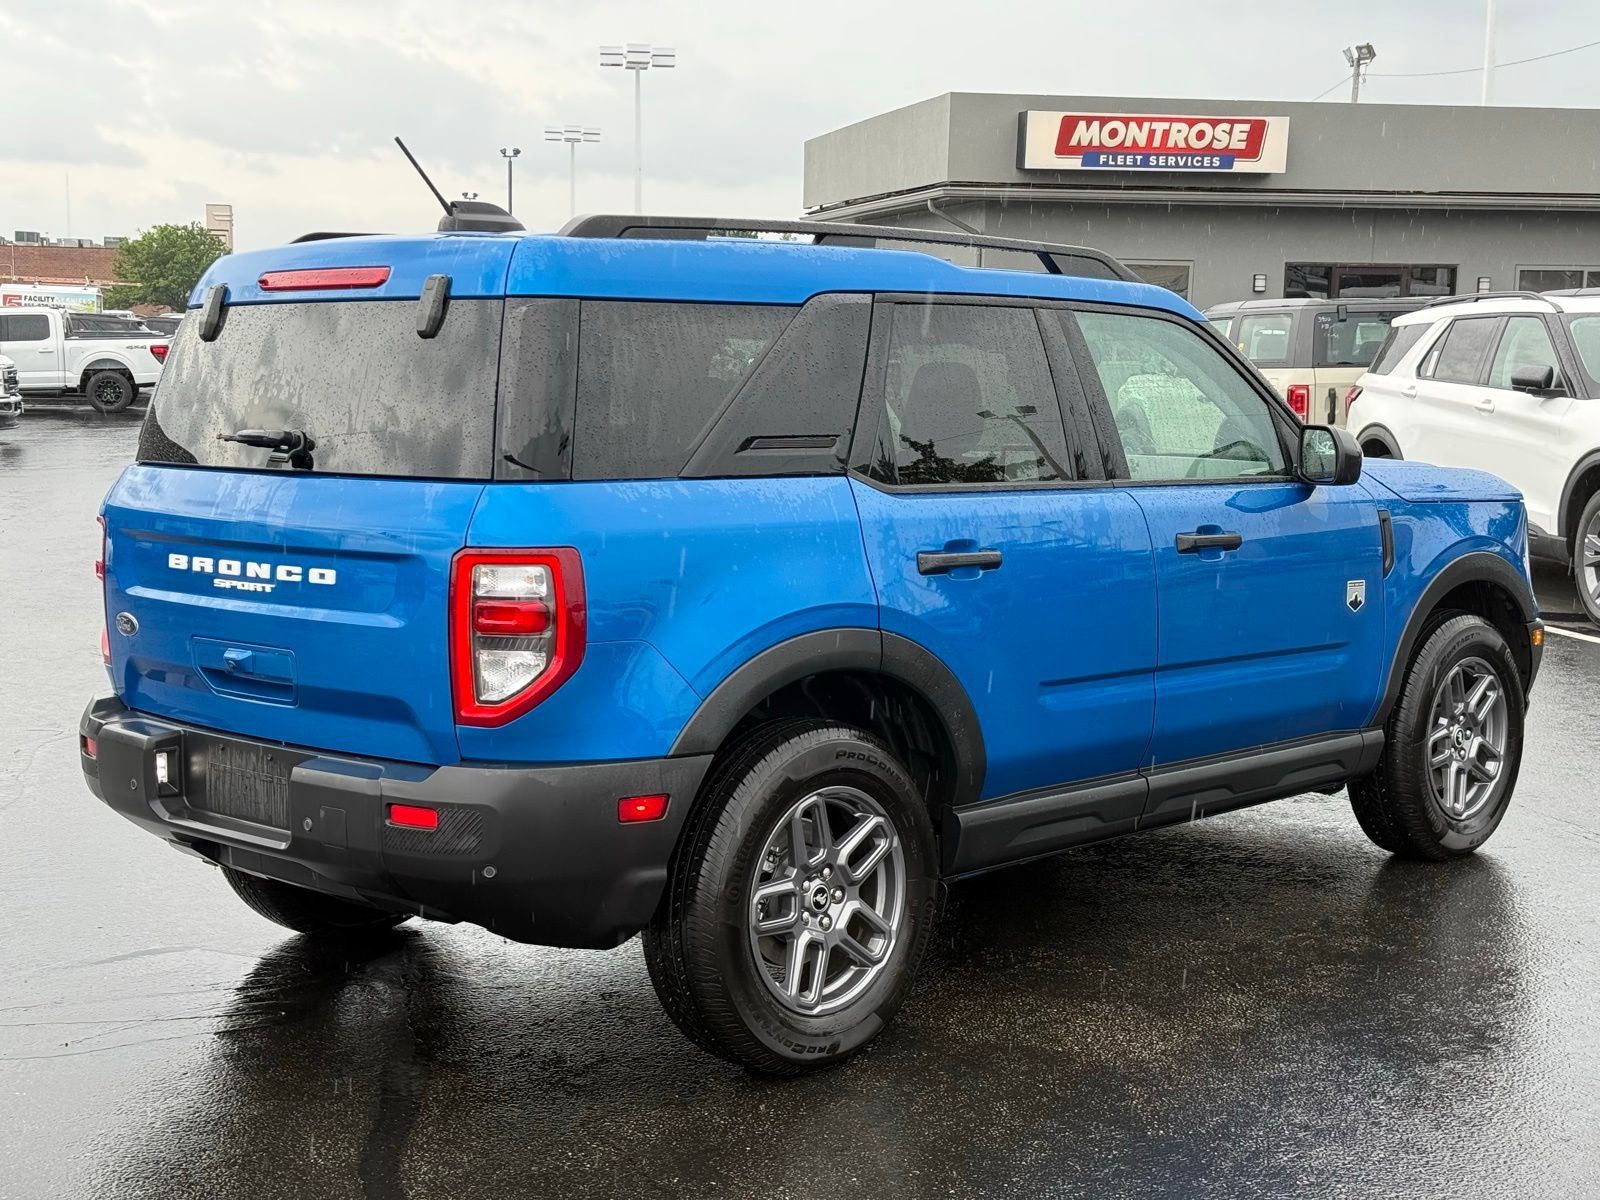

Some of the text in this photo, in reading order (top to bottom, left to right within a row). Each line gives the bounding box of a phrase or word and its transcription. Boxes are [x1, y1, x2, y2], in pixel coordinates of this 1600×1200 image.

[1069, 120, 1251, 150] MONTROSE
[1099, 155, 1221, 167] FLEET SERVICES
[24, 295, 55, 303] FACILITY
[168, 553, 336, 585] BRONCO
[213, 578, 276, 593] SPORT
